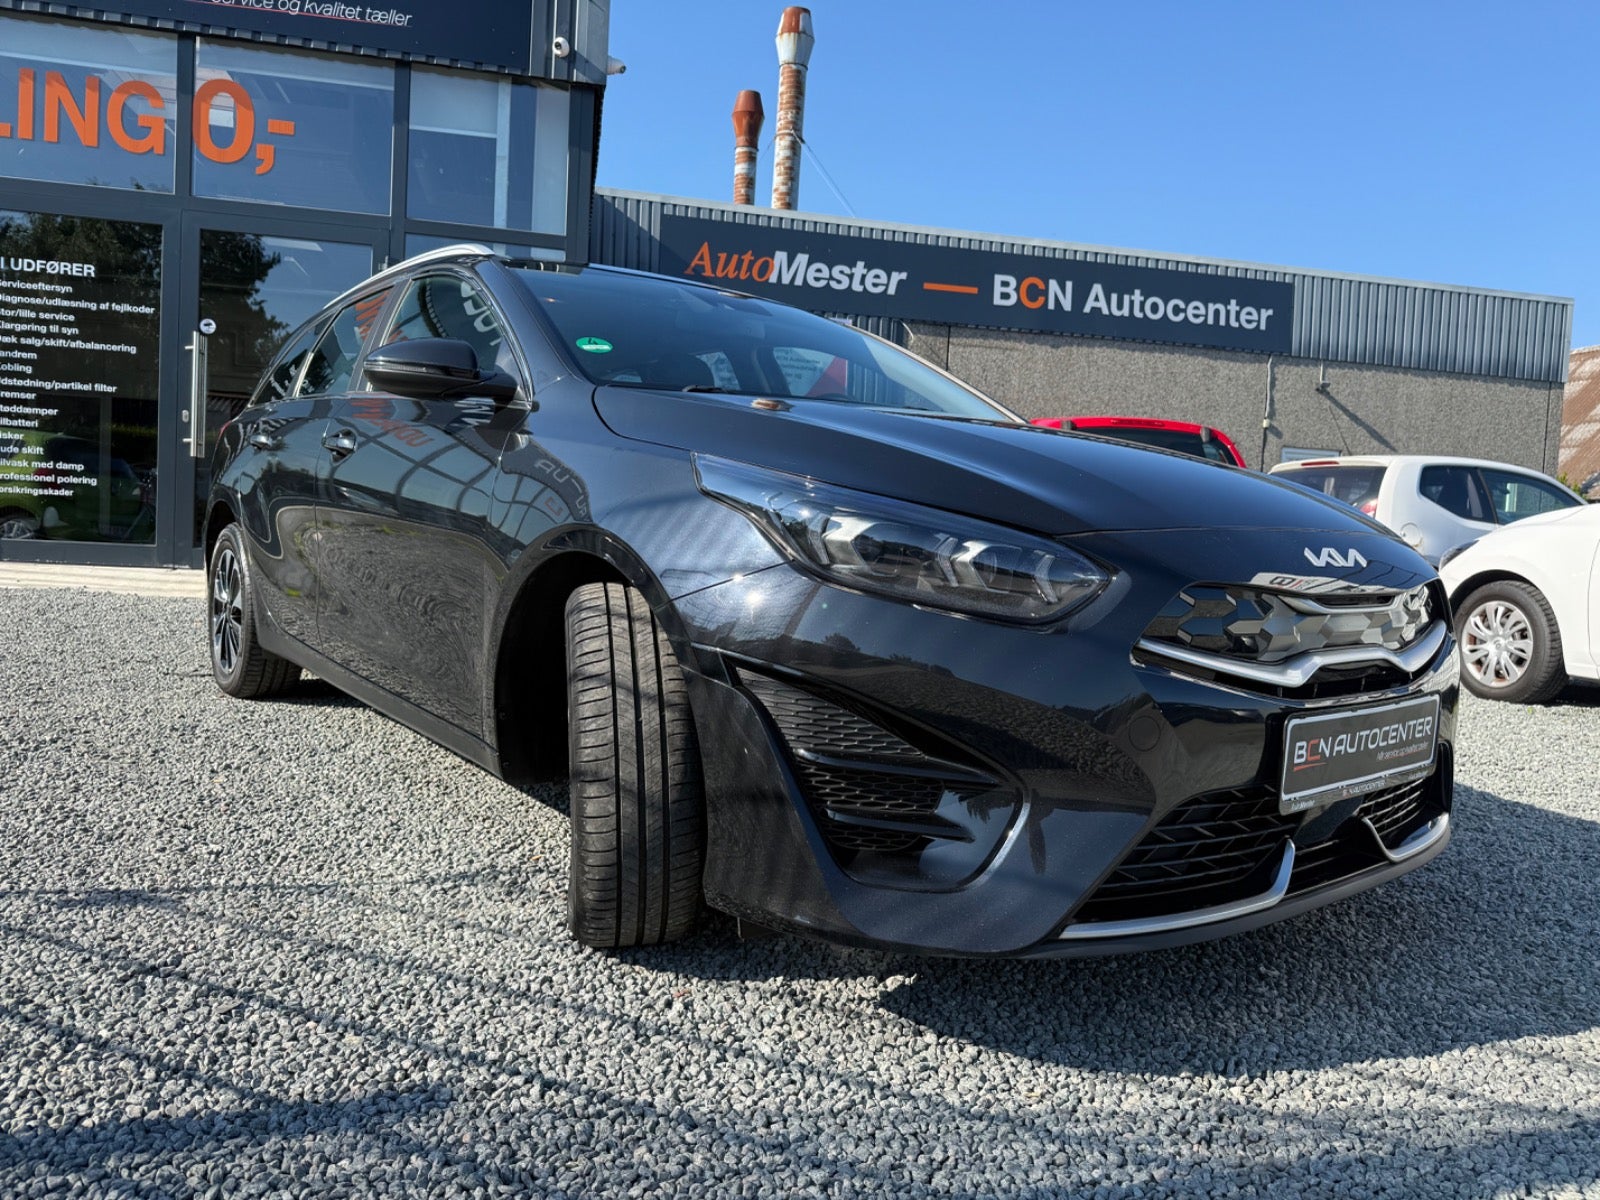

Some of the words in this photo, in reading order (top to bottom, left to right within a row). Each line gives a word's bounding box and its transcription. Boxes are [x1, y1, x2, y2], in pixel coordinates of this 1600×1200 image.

[278, 0, 300, 16] og
[304, 0, 361, 21] kvalitet
[365, 8, 413, 27] tæller
[0, 67, 166, 156] ING
[10, 257, 96, 278] UDFØRER
[683, 241, 907, 296] AutoMester
[0, 293, 97, 311] iagnose/udlæsning
[100, 302, 109, 311] af
[111, 303, 155, 315] fejlkoder
[993, 274, 1073, 312] BCN
[1083, 283, 1274, 331] Autocenter
[0, 308, 37, 318] tor/lille
[39, 312, 75, 321] service
[0, 321, 47, 334] largøring
[49, 324, 59, 333] til
[61, 326, 79, 335] syn
[0, 335, 18, 343] æk
[0, 363, 33, 374] obling
[0, 377, 92, 392] dstødning/partikel
[94, 385, 117, 394] filter
[21, 446, 44, 455] skift
[31, 461, 54, 469] med
[56, 461, 85, 472] damp
[57, 475, 97, 486] polering
[1294, 737, 1332, 764] BCN
[1333, 716, 1433, 757] AUTOCENTER
